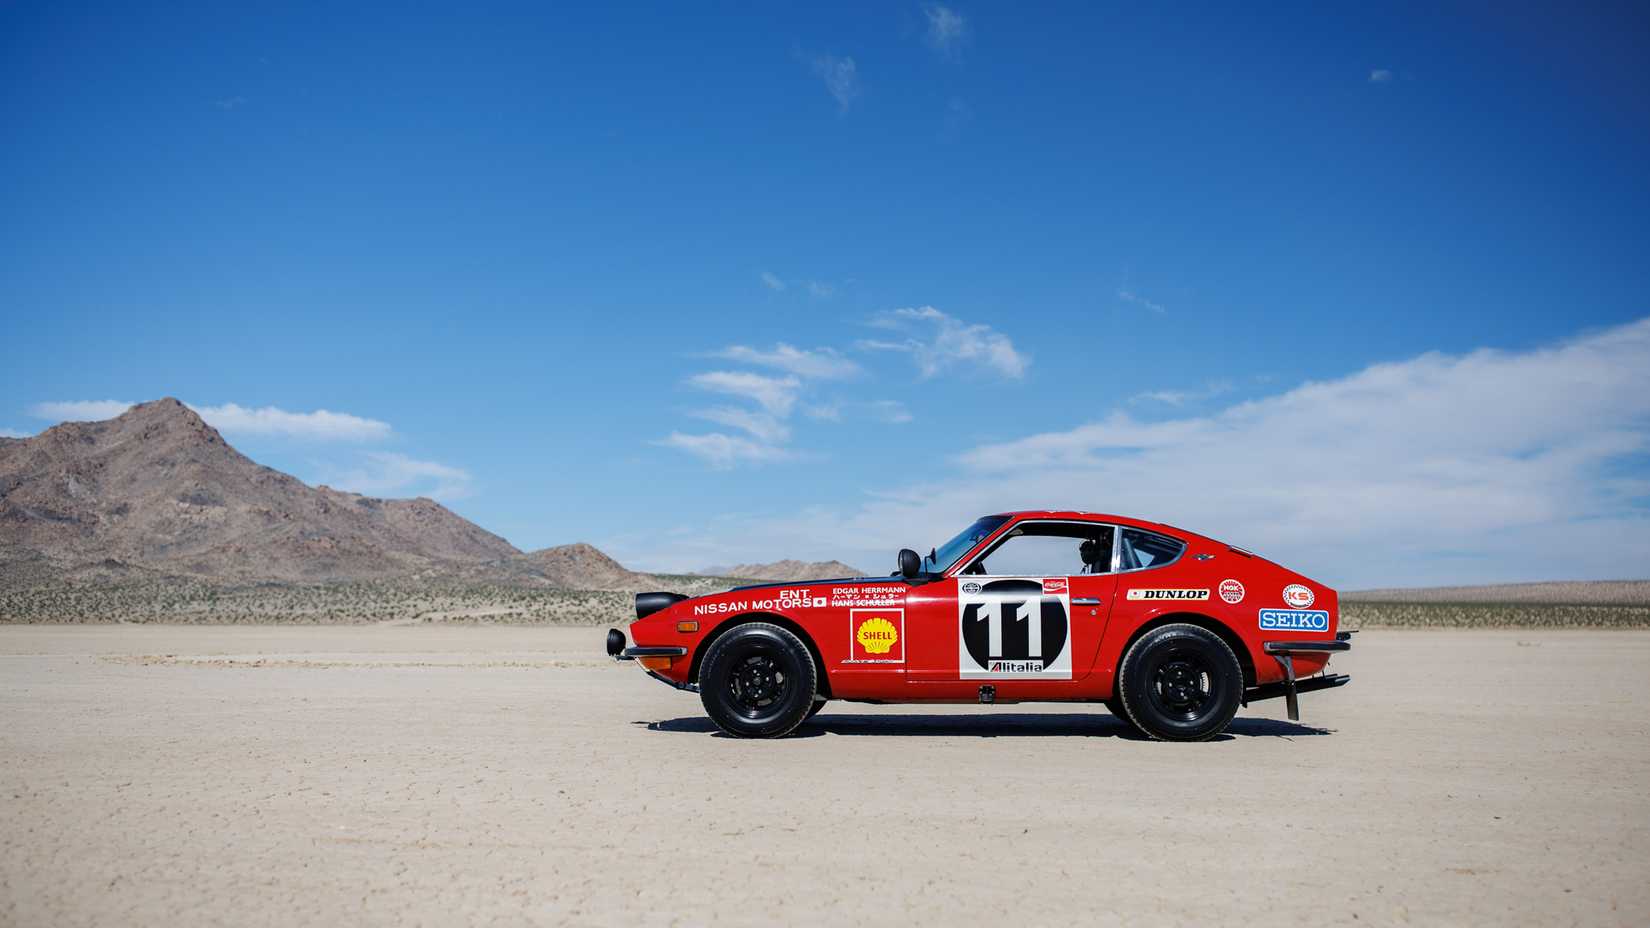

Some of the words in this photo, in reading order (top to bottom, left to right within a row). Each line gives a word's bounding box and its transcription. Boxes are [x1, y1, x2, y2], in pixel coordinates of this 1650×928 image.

[780, 589, 812, 599] ENT.
[861, 586, 906, 594] HERRMANN
[1144, 590, 1208, 599] DUNLOP
[1288, 591, 1309, 601] KS
[694, 601, 748, 615] NISSAN
[752, 598, 812, 610] MOTORS
[831, 599, 854, 607] HANS
[1262, 612, 1326, 629] SEIKO
[976, 598, 1042, 657] 11
[863, 631, 892, 640] SHELL
[990, 661, 1043, 673] Alitalia
